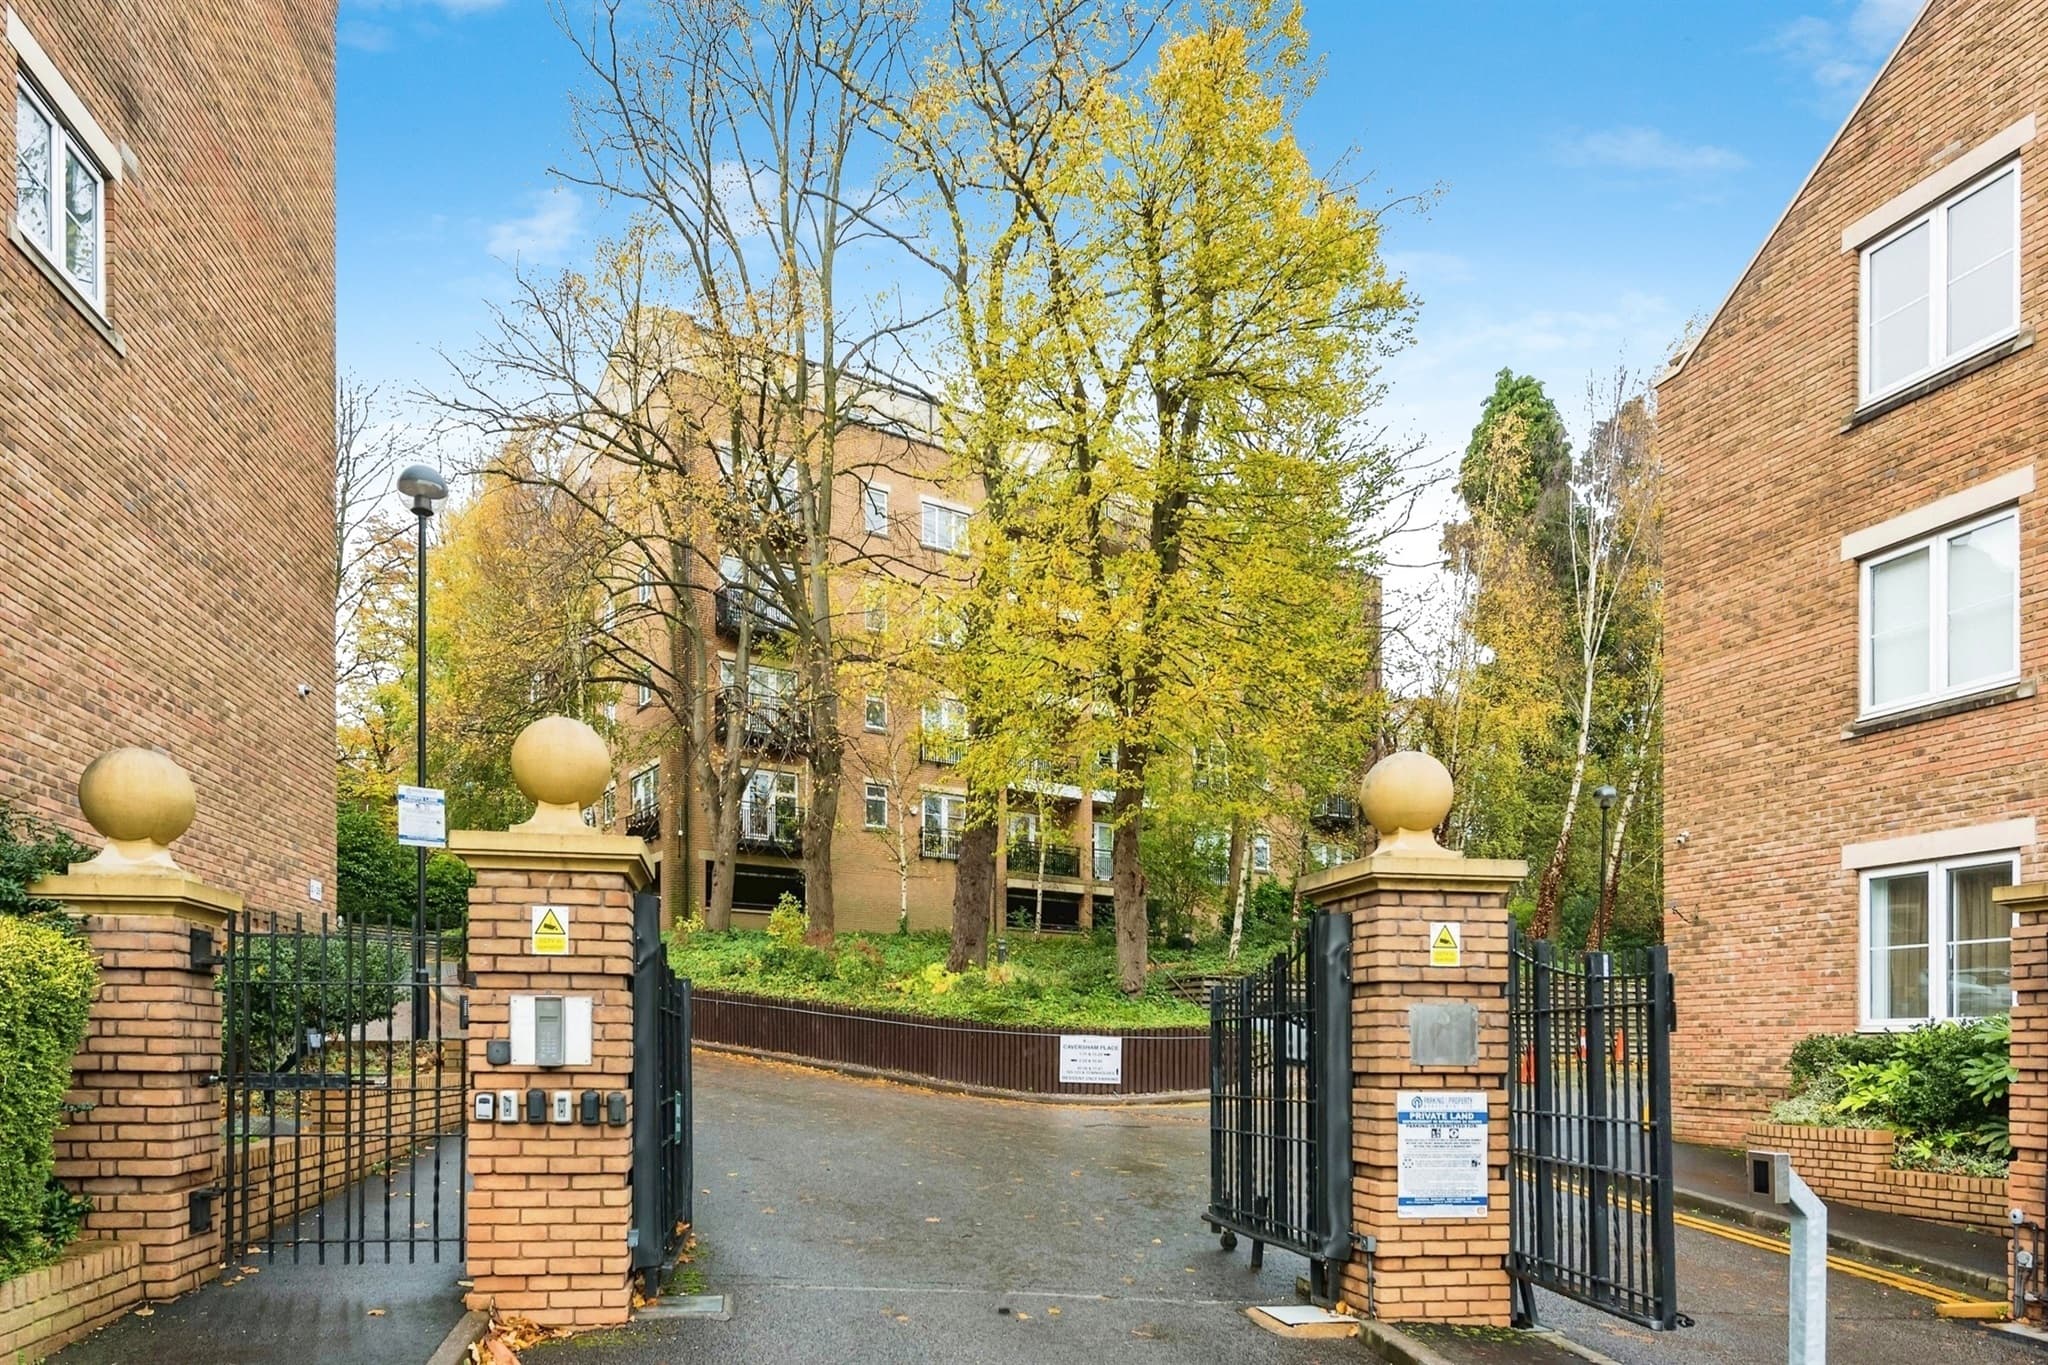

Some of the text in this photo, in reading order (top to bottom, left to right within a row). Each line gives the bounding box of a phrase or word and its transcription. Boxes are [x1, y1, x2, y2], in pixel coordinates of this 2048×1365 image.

[1448, 1097, 1473, 1105] PROPERTY
[1409, 1112, 1475, 1120] PRIVATE LAND
